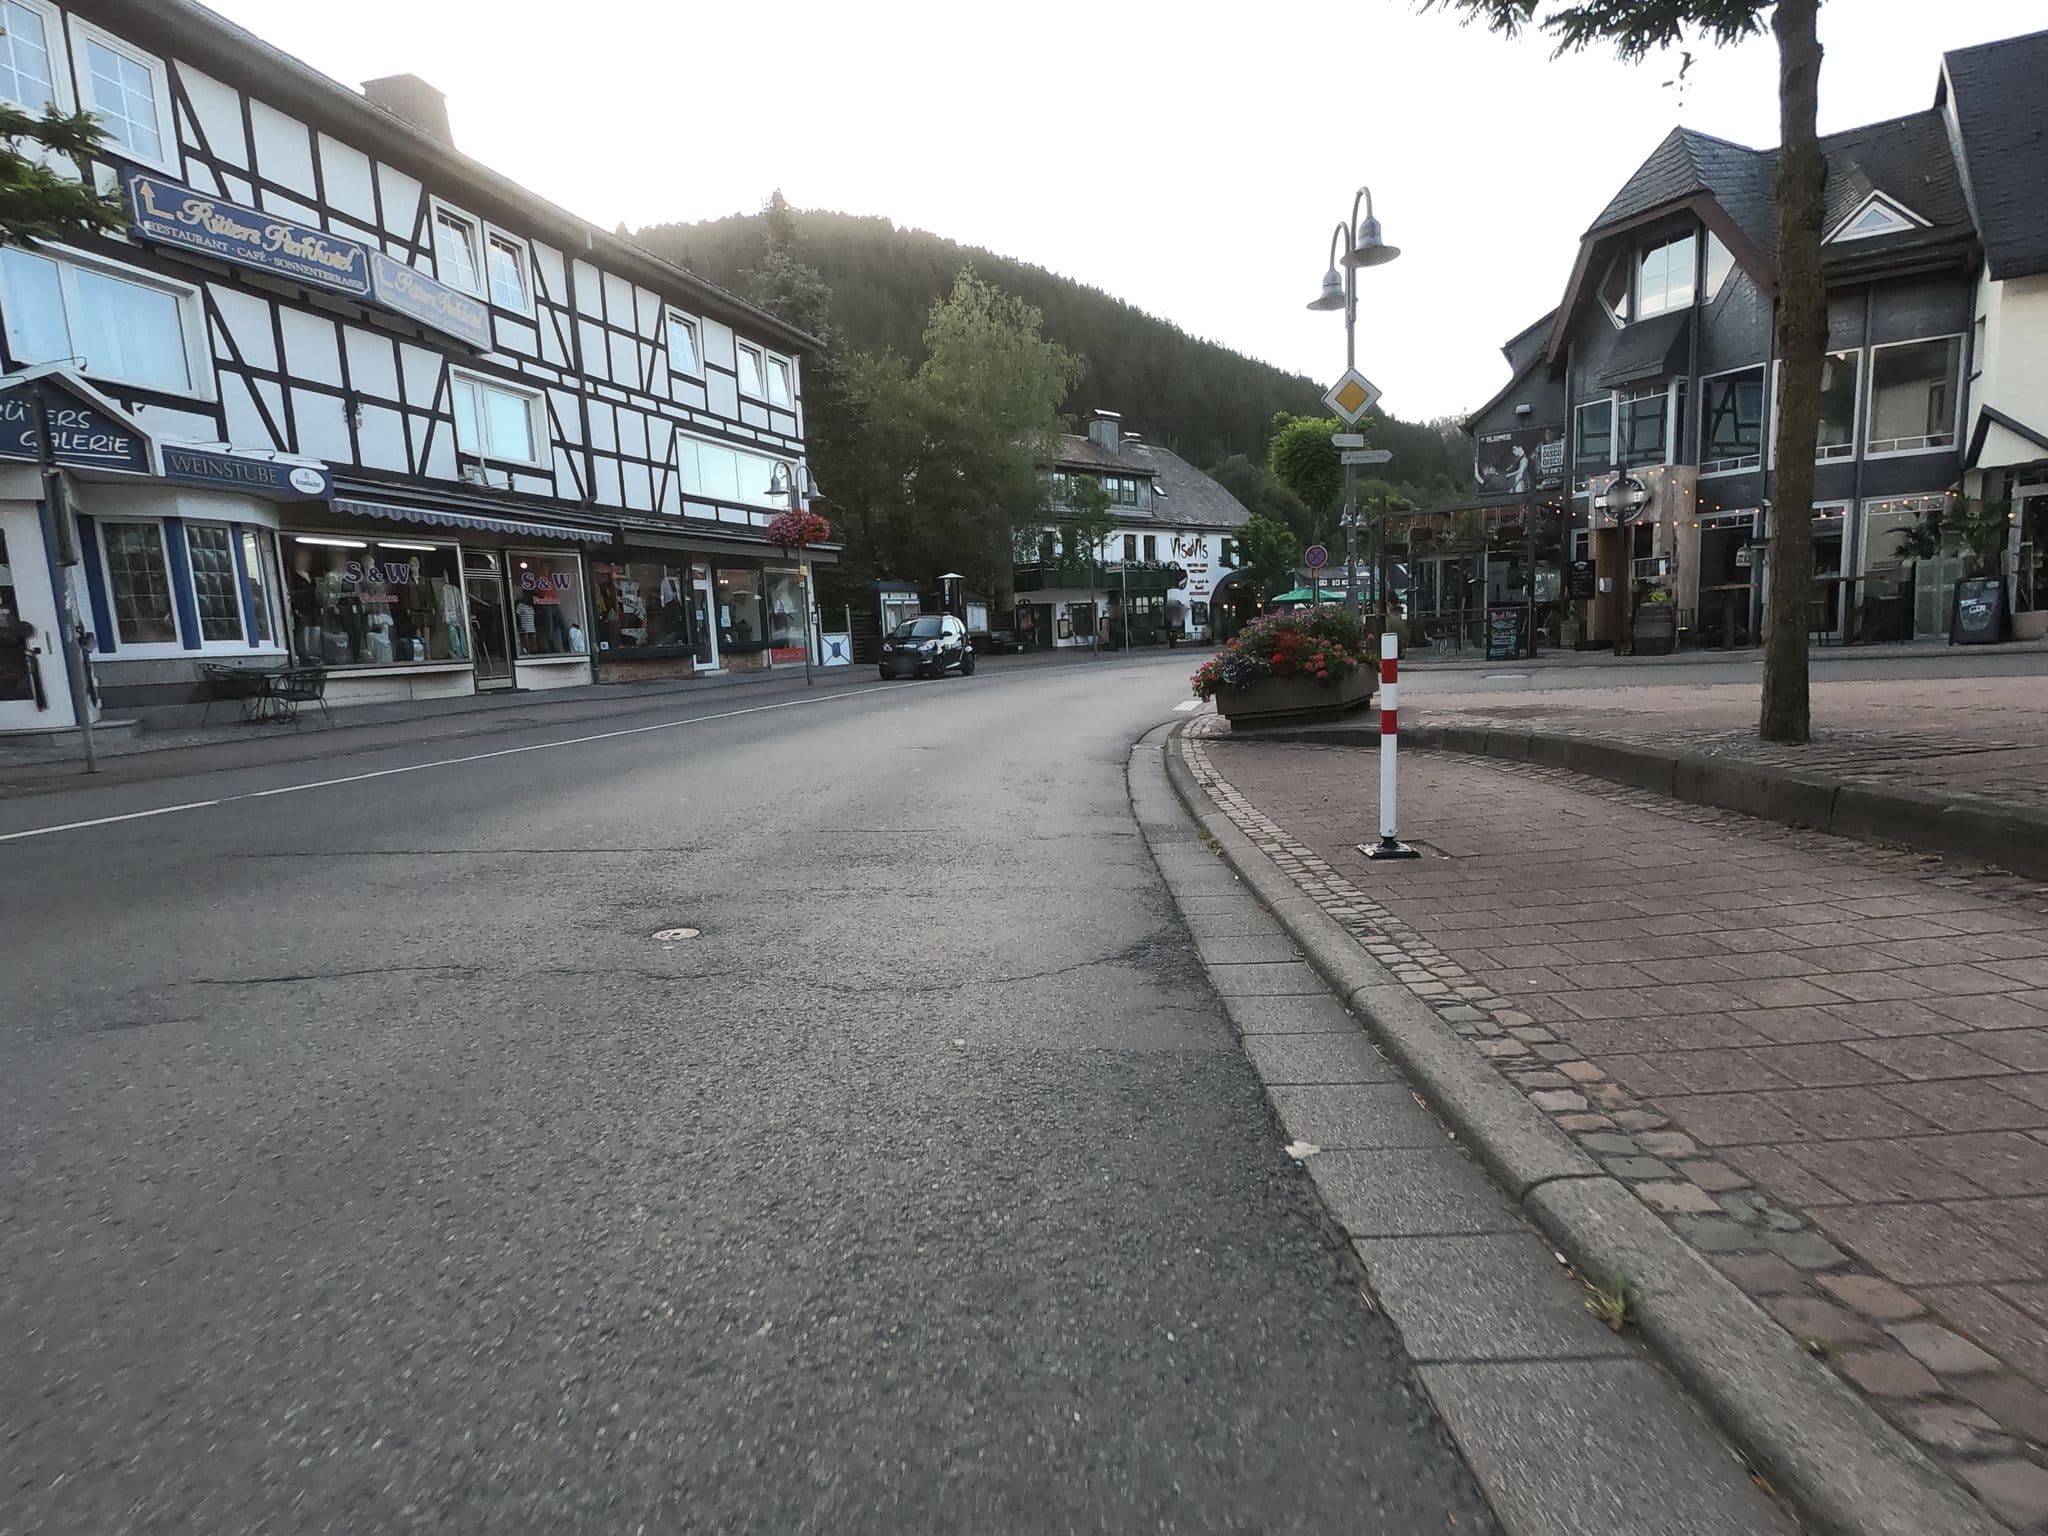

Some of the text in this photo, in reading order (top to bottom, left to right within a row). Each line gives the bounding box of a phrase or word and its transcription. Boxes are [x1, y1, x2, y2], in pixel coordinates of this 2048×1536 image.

[144, 220, 229, 252] RESTAURANT
[274, 257, 365, 289] SONNENTERRASSE
[262, 224, 361, 272] Parkhotel
[170, 455, 278, 485] WEINSTUBE
[344, 561, 410, 584] S & W
[521, 572, 571, 590] S & W
